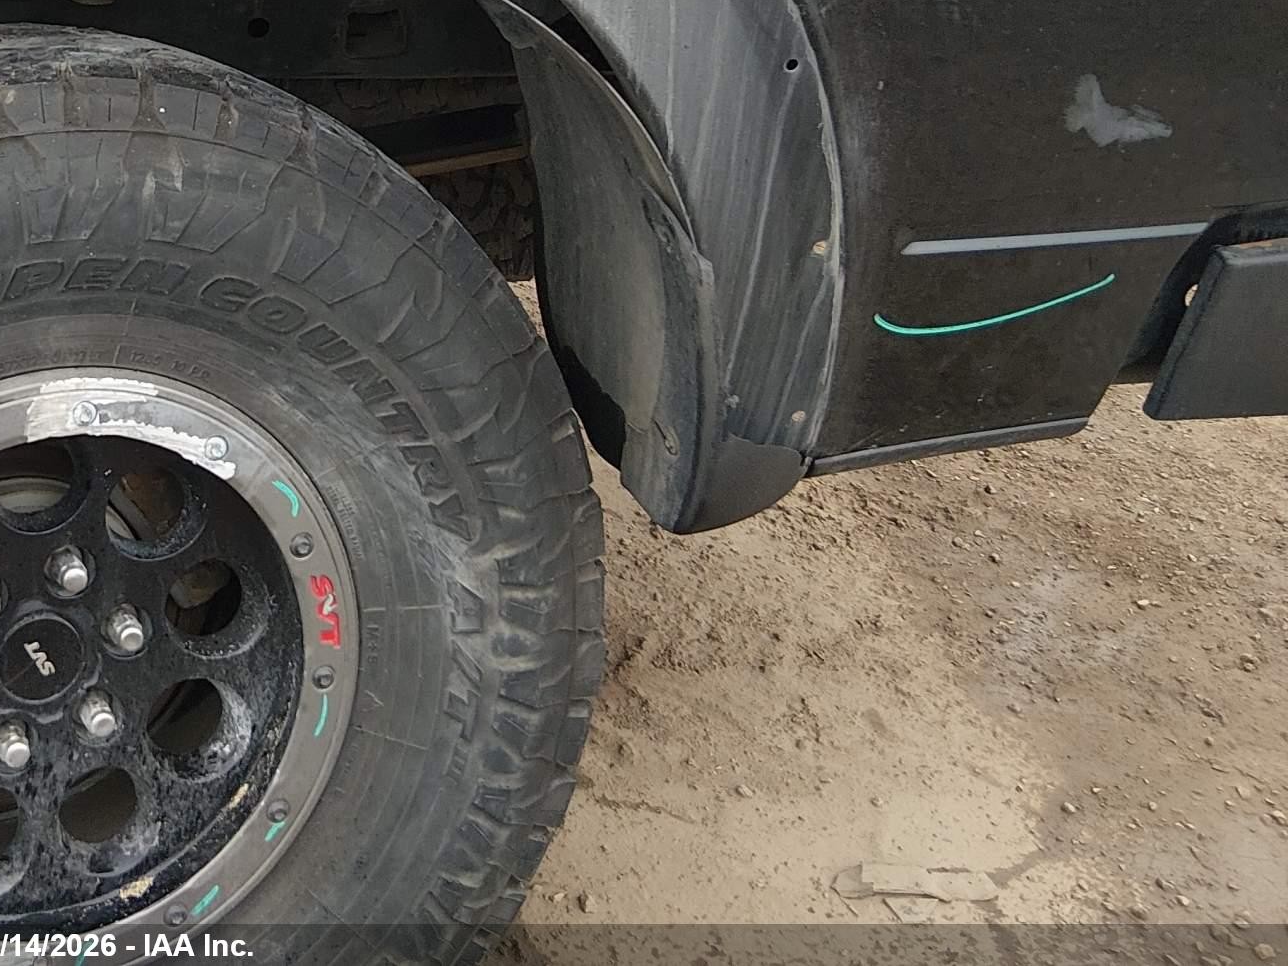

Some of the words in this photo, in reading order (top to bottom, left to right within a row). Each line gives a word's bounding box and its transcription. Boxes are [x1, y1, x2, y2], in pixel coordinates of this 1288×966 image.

[197, 275, 476, 542] COUNTRY
[309, 575, 341, 649] SVT
[23, 641, 56, 677] SVT
